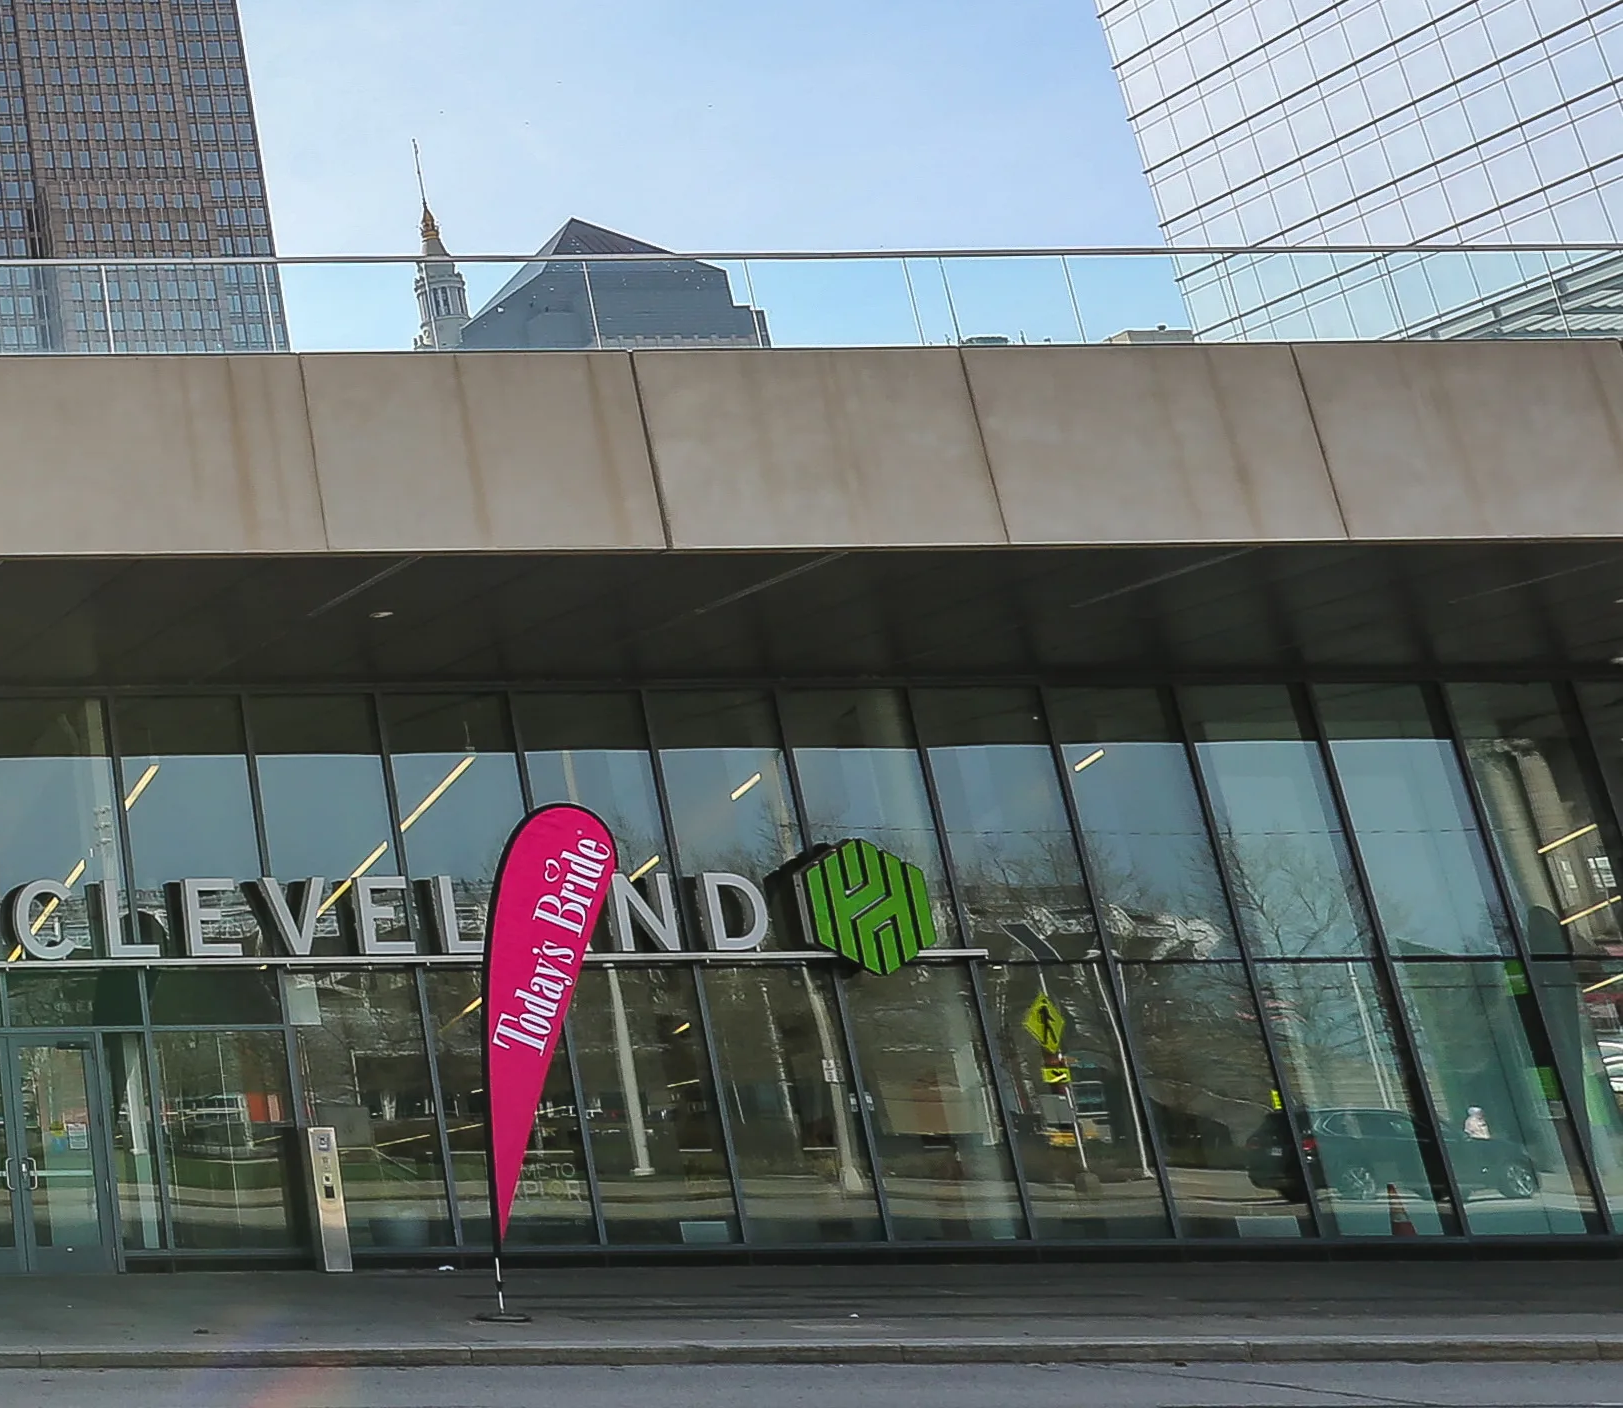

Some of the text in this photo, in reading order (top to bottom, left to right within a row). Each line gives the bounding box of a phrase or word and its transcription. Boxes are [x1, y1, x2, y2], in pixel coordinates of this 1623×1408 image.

[12, 871, 769, 962] CLEVELND
[492, 837, 611, 1057] Today's Bride
